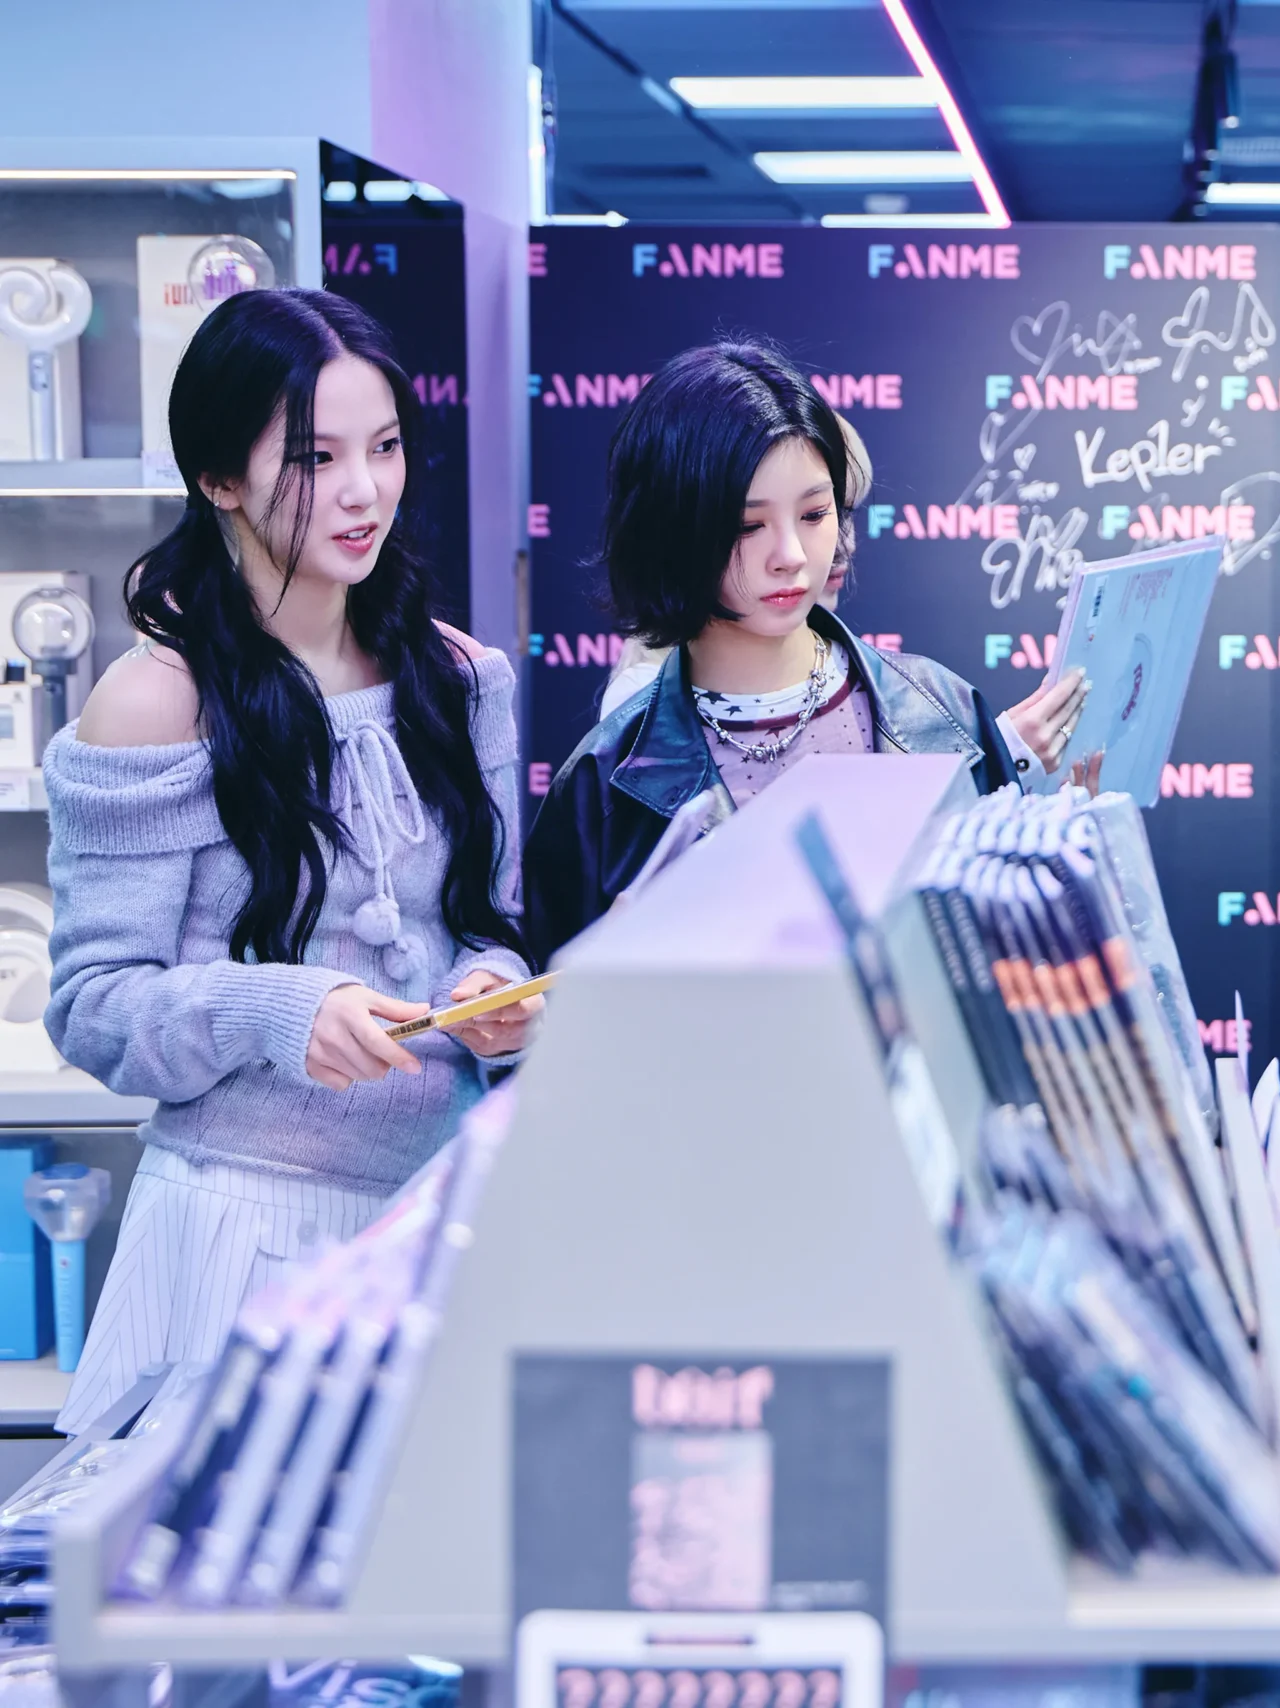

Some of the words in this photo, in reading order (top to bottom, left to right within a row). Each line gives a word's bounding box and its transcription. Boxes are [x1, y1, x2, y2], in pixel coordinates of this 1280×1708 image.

[633, 243, 784, 279] FANME
[868, 243, 1021, 280] FANME
[1104, 244, 1257, 281] FANME
[810, 374, 903, 410] NME
[985, 374, 1139, 410] FANME
[868, 504, 1022, 539] FANME
[1102, 505, 1256, 541] FANME
[1161, 763, 1254, 799] NME
